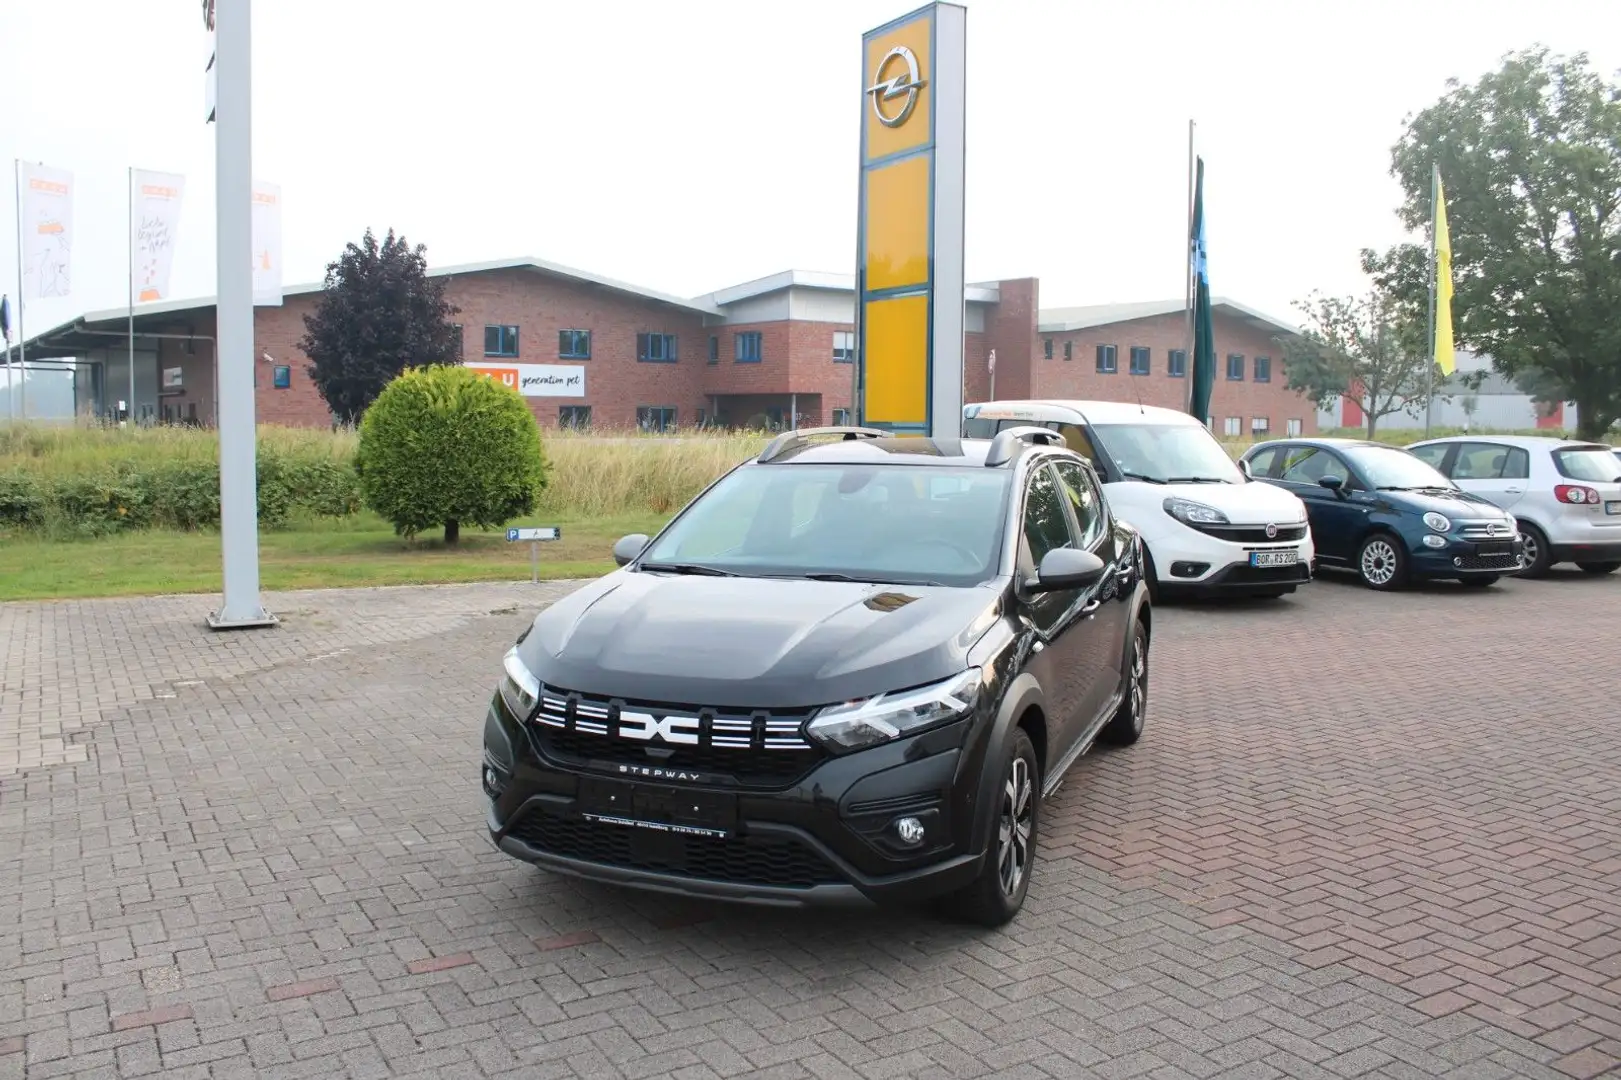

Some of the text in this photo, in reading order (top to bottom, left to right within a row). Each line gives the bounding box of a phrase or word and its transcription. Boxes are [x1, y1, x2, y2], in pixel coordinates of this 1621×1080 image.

[522, 374, 564, 388] generation
[566, 374, 580, 388] pet
[1256, 554, 1270, 564] BOR
[619, 765, 699, 780] STEPWAY
